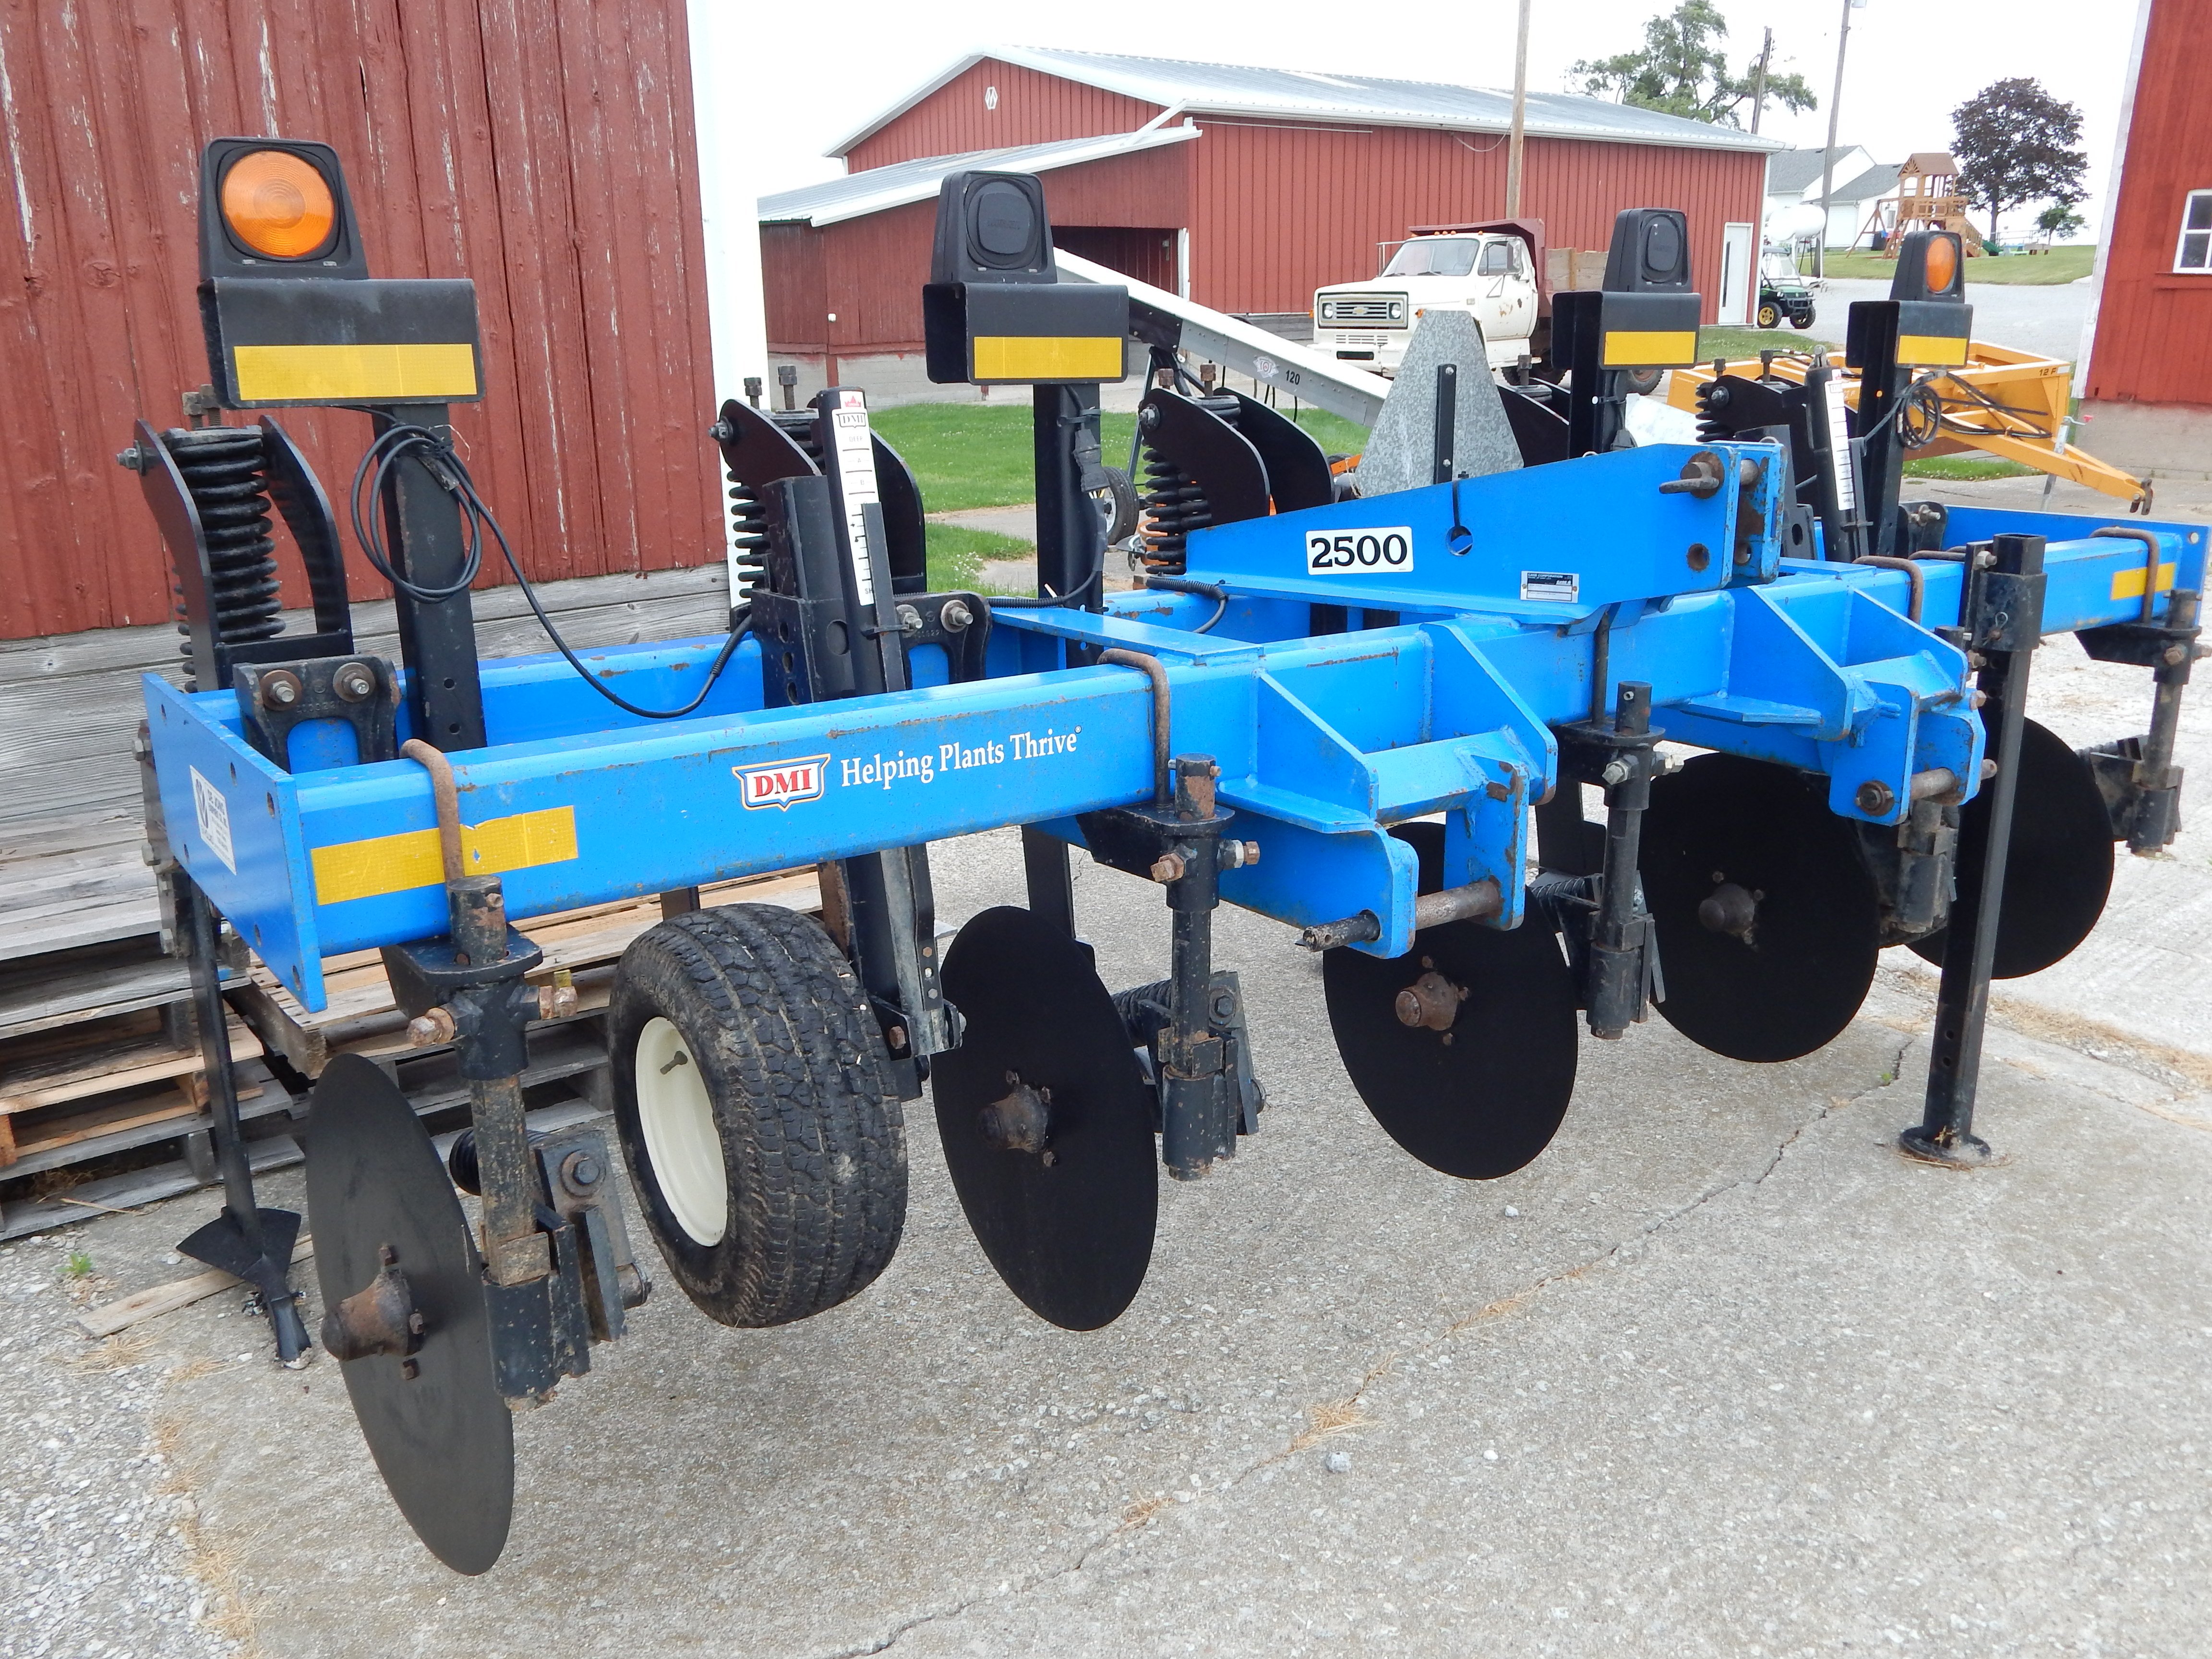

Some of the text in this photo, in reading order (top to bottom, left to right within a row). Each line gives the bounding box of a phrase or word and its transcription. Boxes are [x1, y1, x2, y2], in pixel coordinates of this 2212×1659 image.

[1286, 370, 1300, 385] 120
[1311, 534, 1407, 568] 2500
[841, 750, 934, 790] Helping
[939, 739, 1004, 772] Plants
[754, 769, 812, 798] DMI
